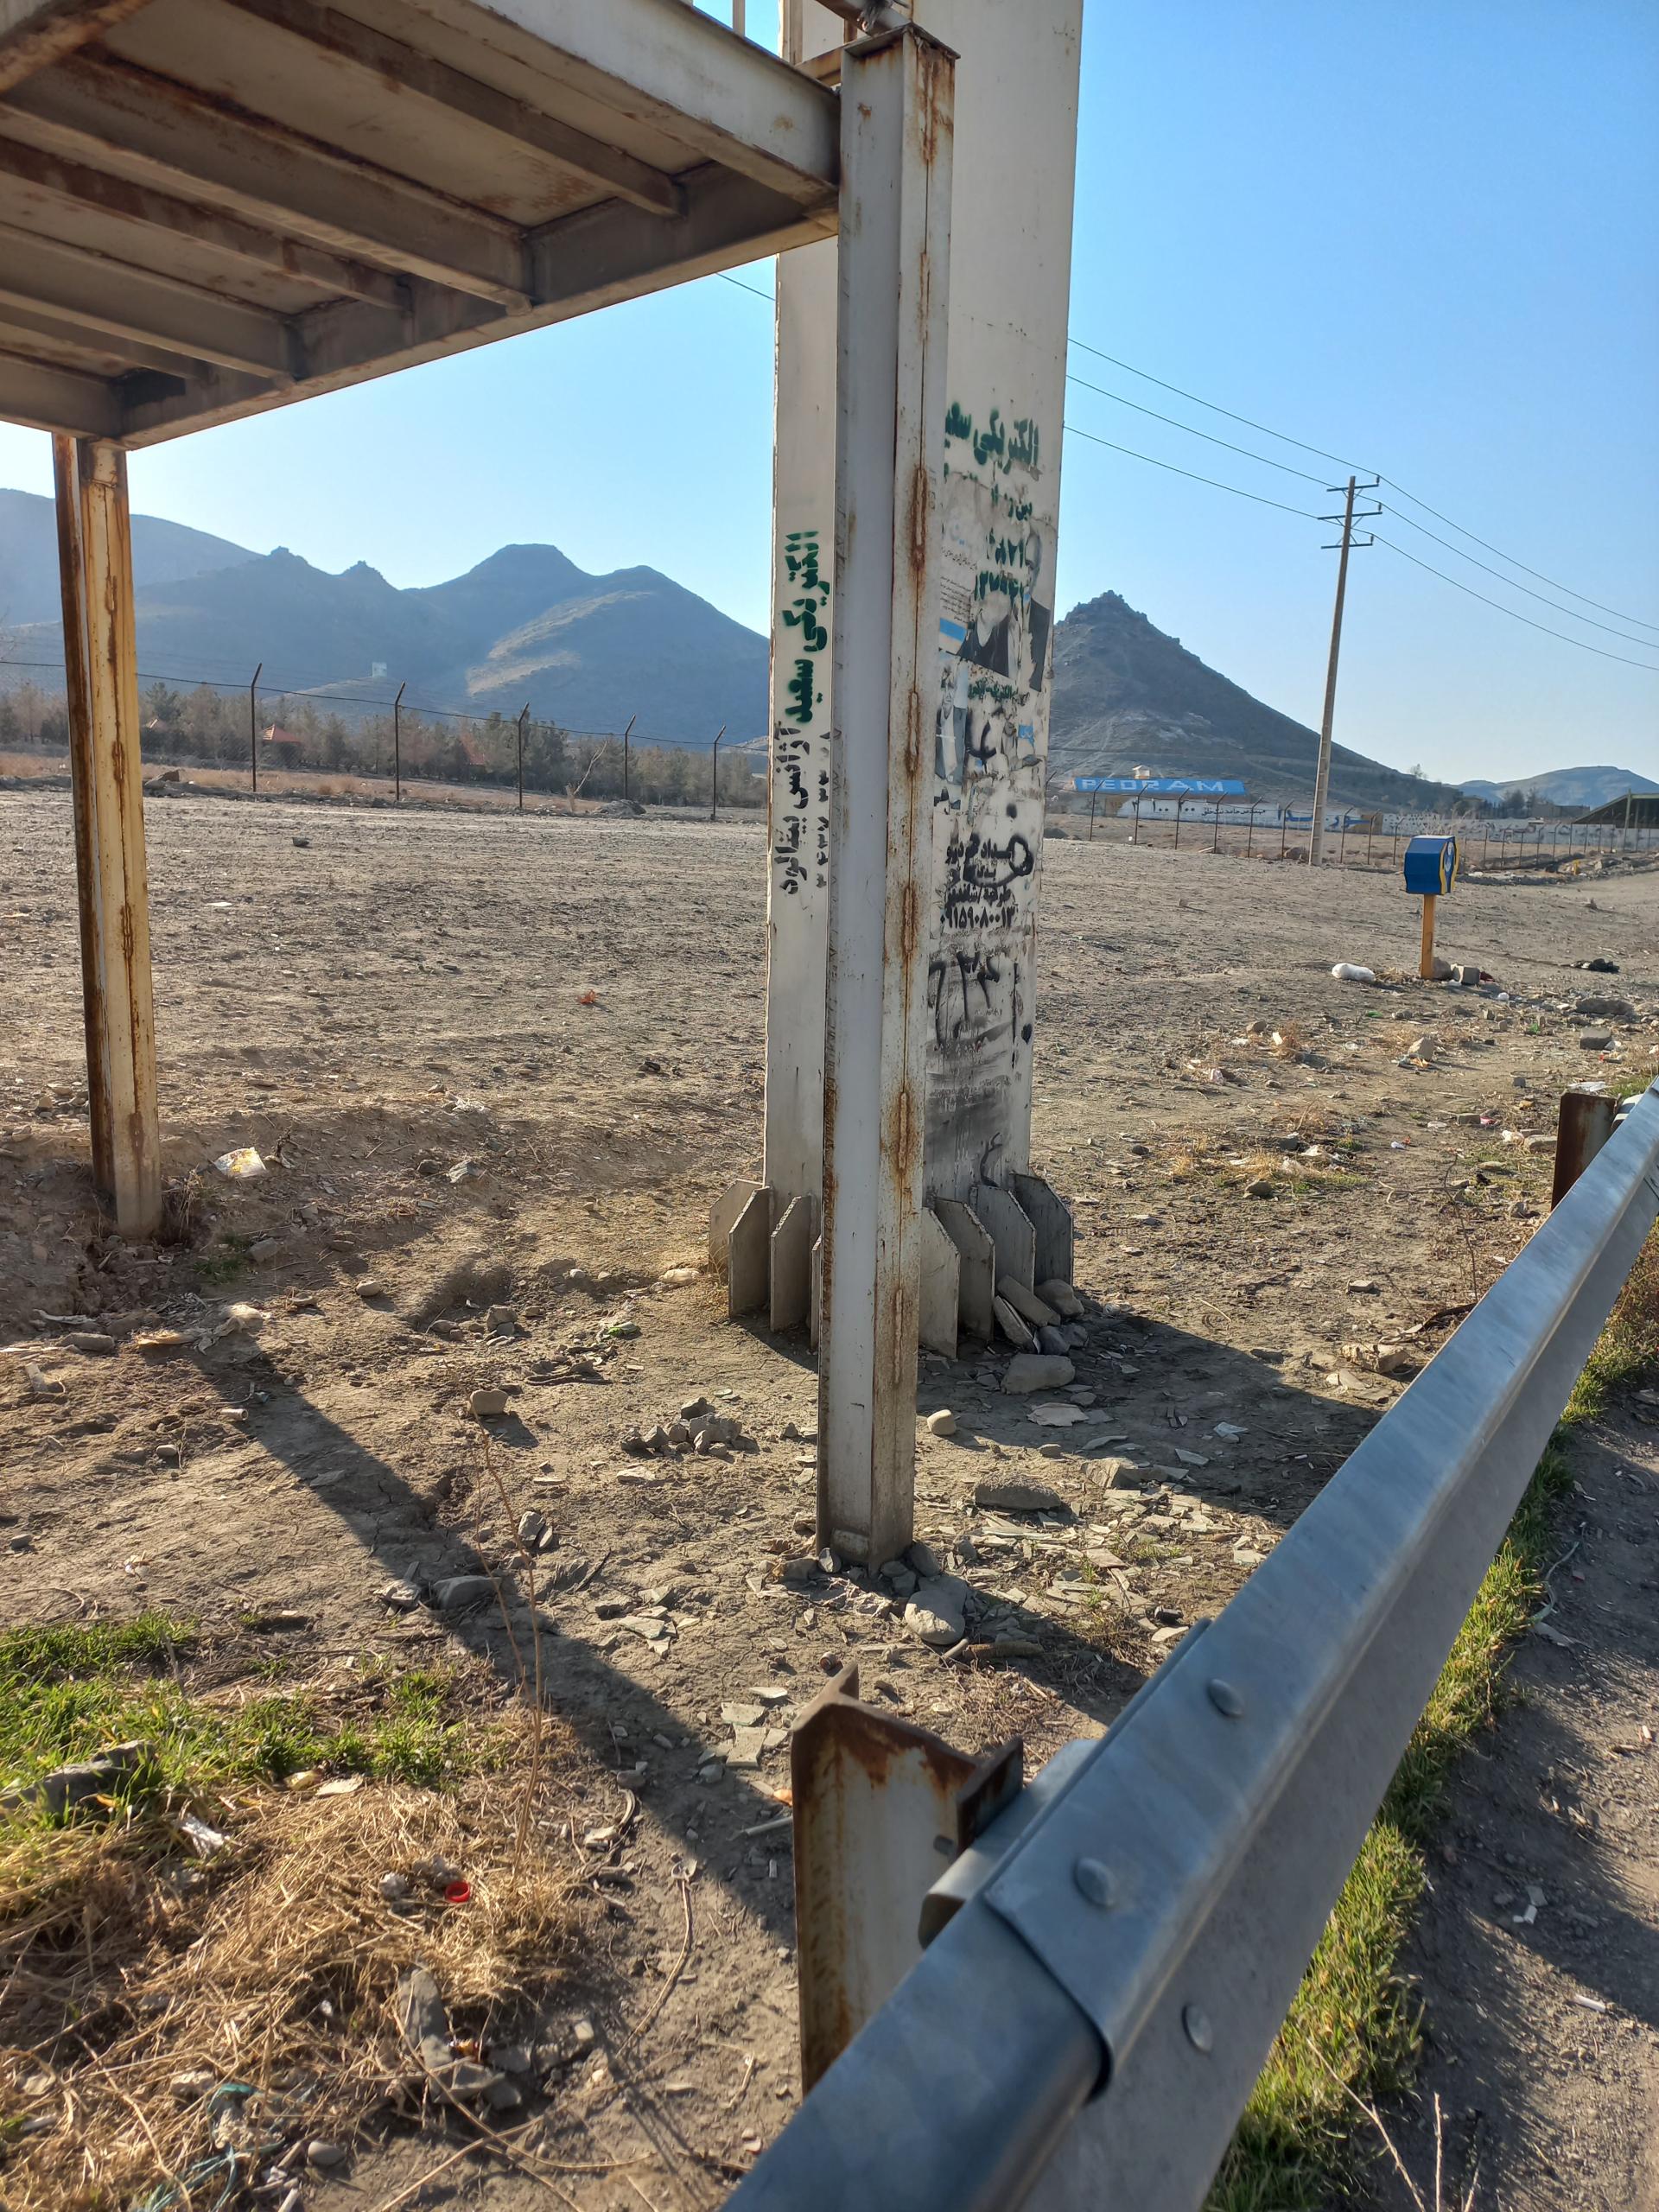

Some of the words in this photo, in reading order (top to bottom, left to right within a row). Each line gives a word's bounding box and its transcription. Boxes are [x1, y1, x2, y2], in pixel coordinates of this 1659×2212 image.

[782, 530, 830, 652] الکتریکی
[784, 658, 823, 723] سعید
[1082, 779, 1224, 792] PEDRAM
